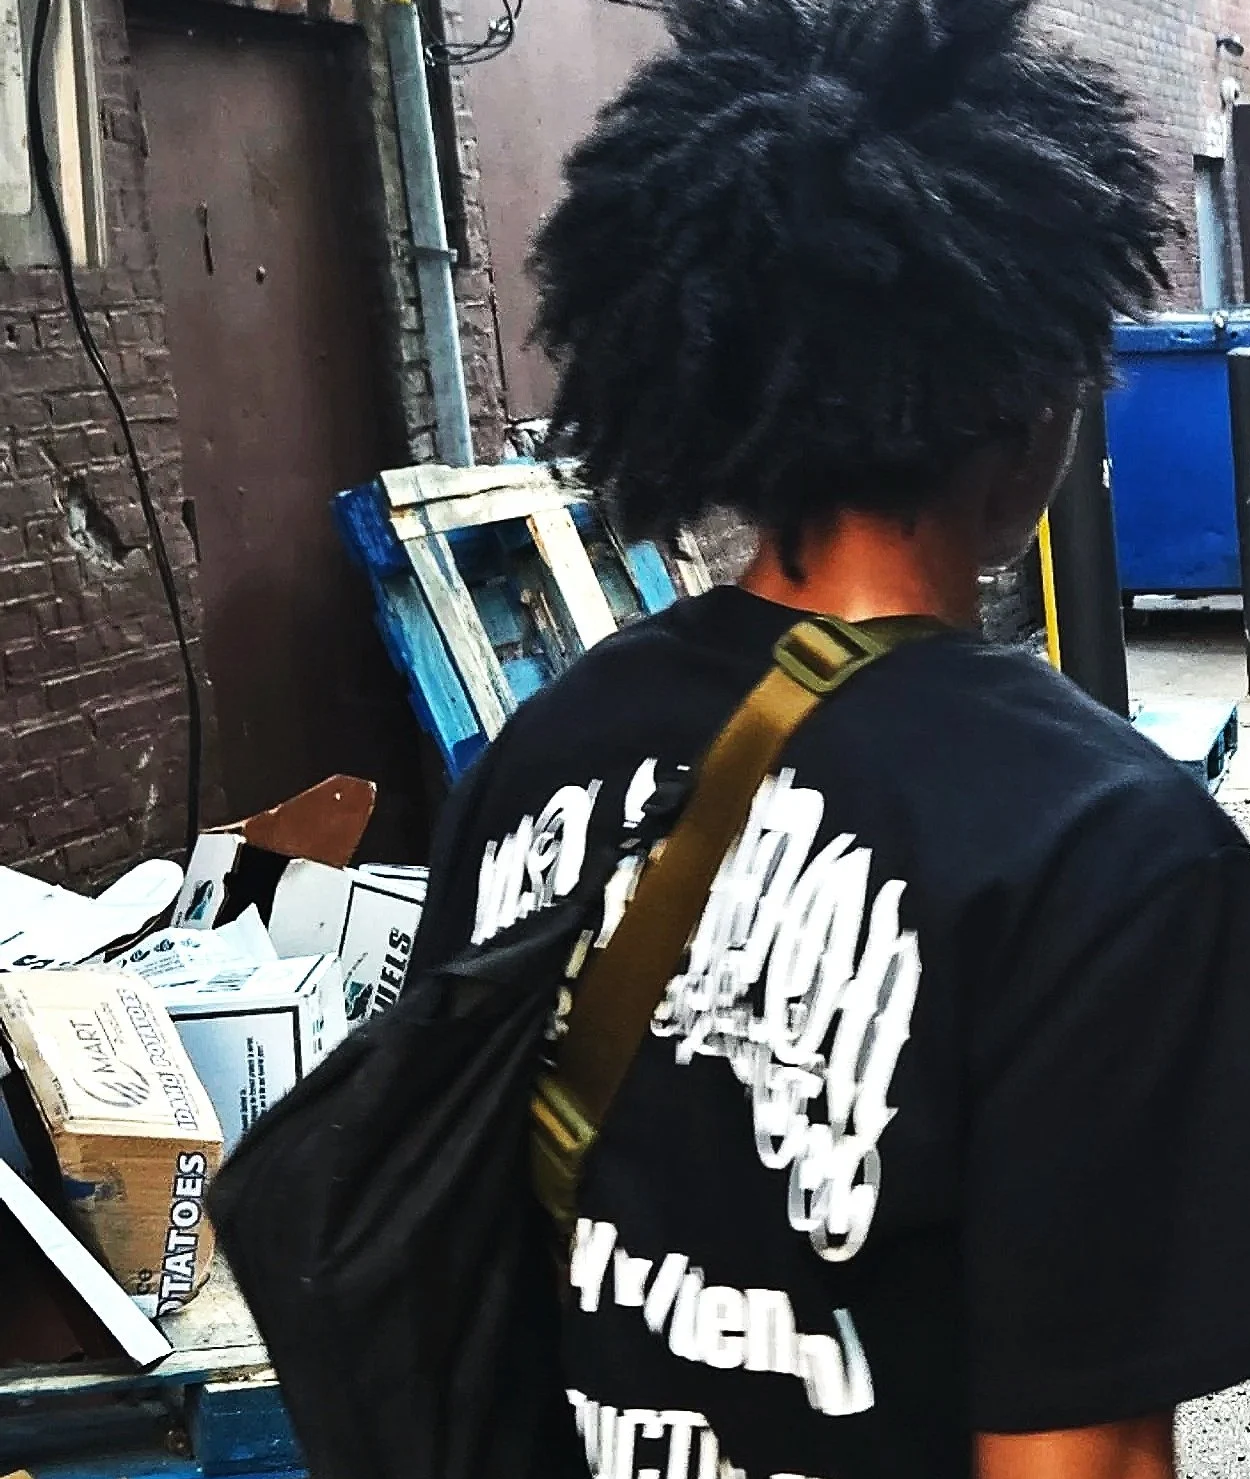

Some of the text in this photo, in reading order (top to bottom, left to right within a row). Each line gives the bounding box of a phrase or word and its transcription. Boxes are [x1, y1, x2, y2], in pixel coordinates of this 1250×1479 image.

[69, 1019, 116, 1073] MART
[115, 987, 172, 1067] POTATOES
[157, 1072, 199, 1131] IDAHO
